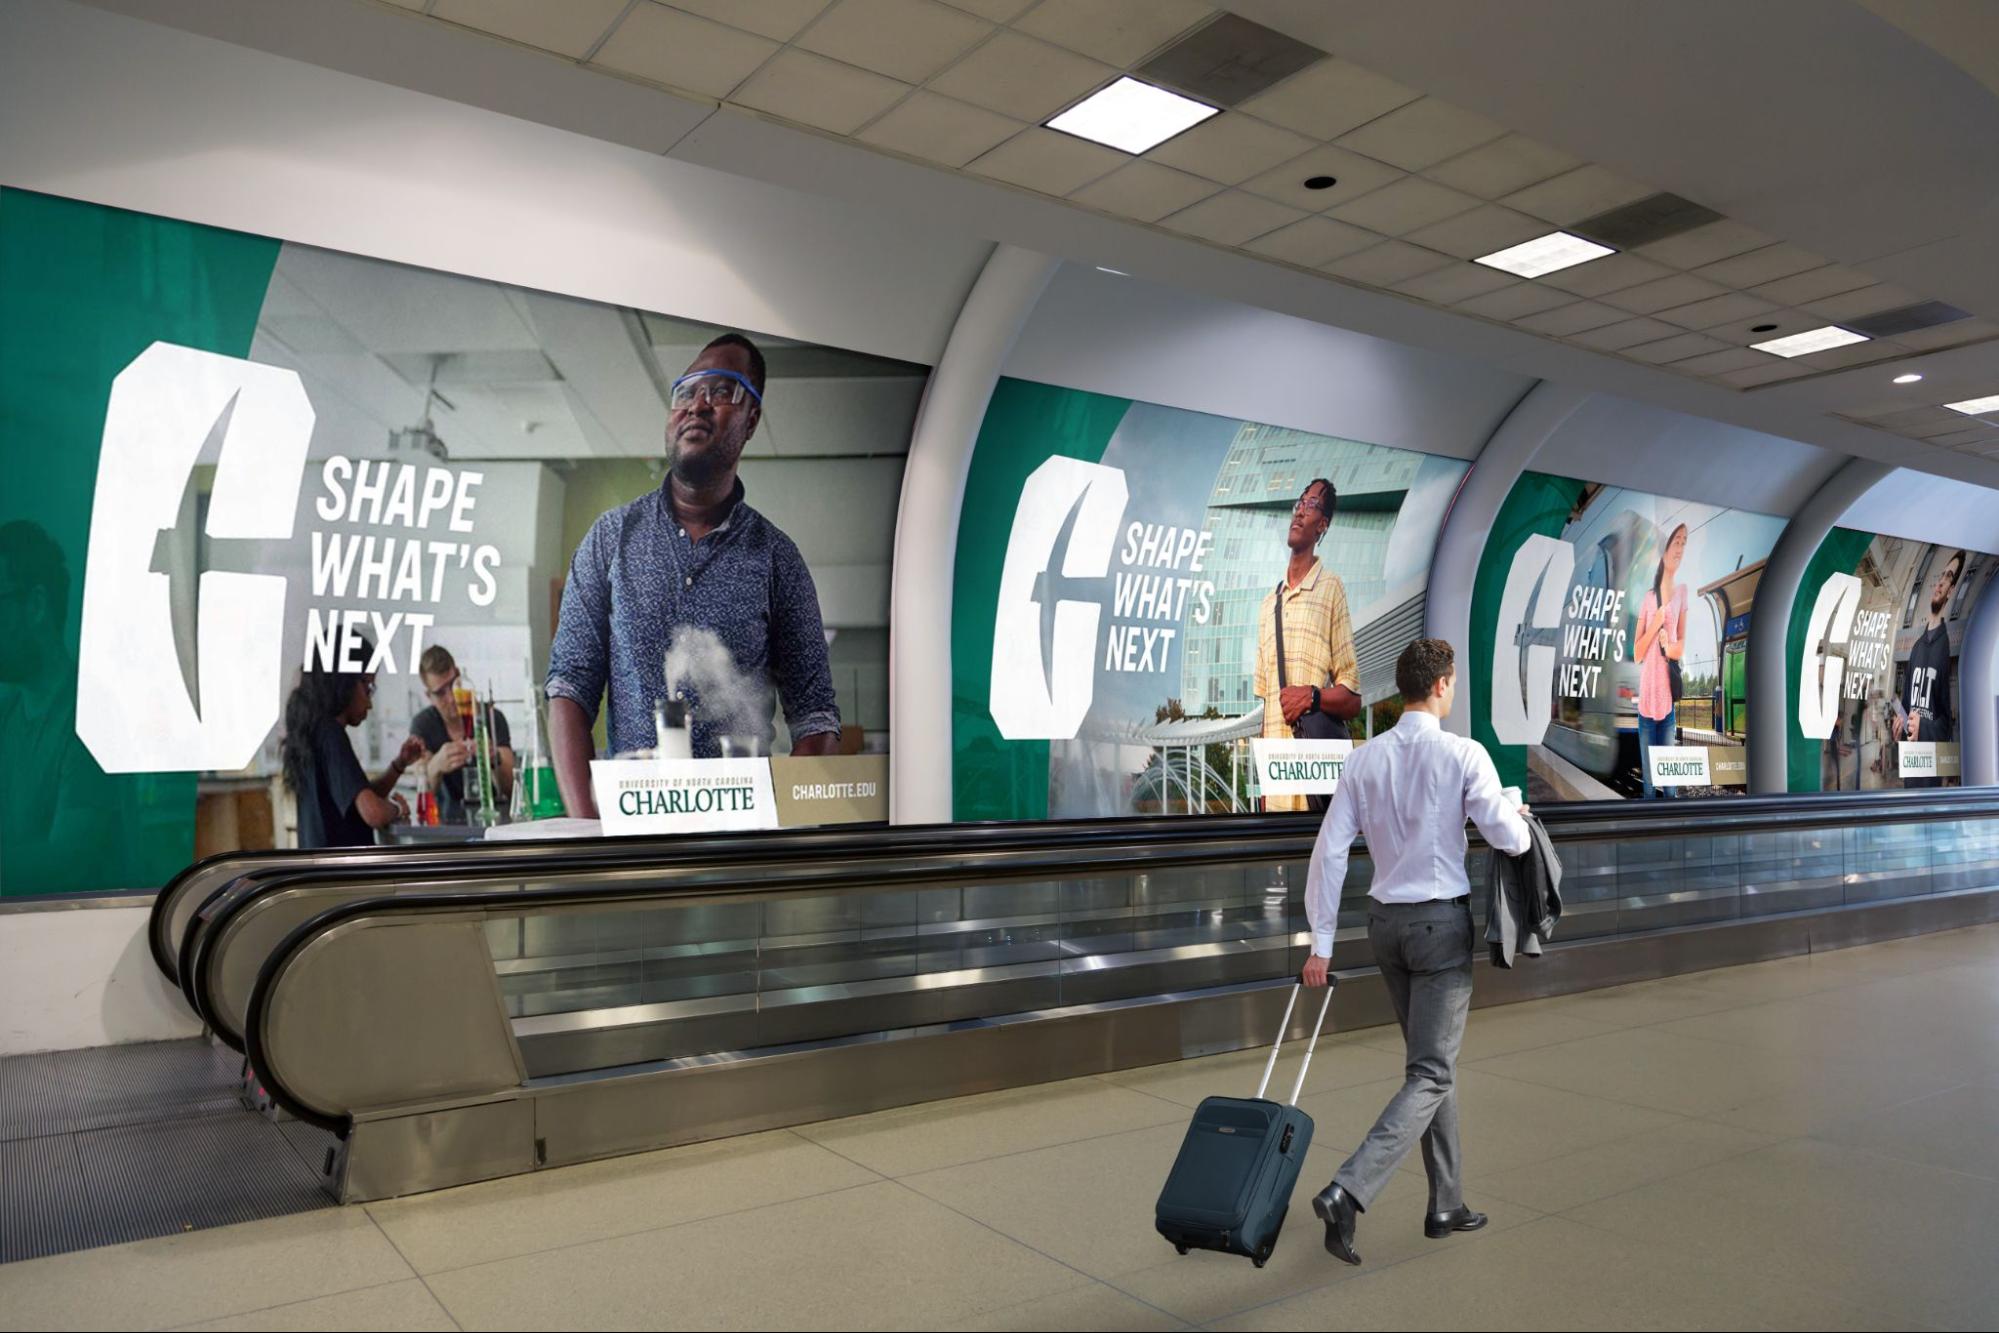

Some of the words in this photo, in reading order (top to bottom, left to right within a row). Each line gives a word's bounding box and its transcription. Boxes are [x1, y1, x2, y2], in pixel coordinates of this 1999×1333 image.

[316, 455, 484, 533] SHAPE
[1121, 521, 1214, 572] SHAPE
[311, 531, 501, 607] WHAT'S
[1114, 572, 1215, 624] WHAT'S
[1568, 584, 1625, 623] SHAPE
[303, 608, 435, 675] NEXT
[1563, 624, 1626, 662] WHAT'S
[1854, 609, 1892, 639] SHAPE
[1105, 625, 1176, 673] NEXT
[1848, 639, 1890, 671] WHAT'S
[1558, 663, 1602, 698] NEXT
[1843, 671, 1873, 700] NEXT
[1910, 666, 1937, 709] CLT
[715, 776, 753, 786] CAROLINA
[1657, 762, 1703, 776] CHARLOTTE
[619, 787, 755, 816] CHARLOTTE
[792, 782, 876, 801] CHARLOTTE.EDU
